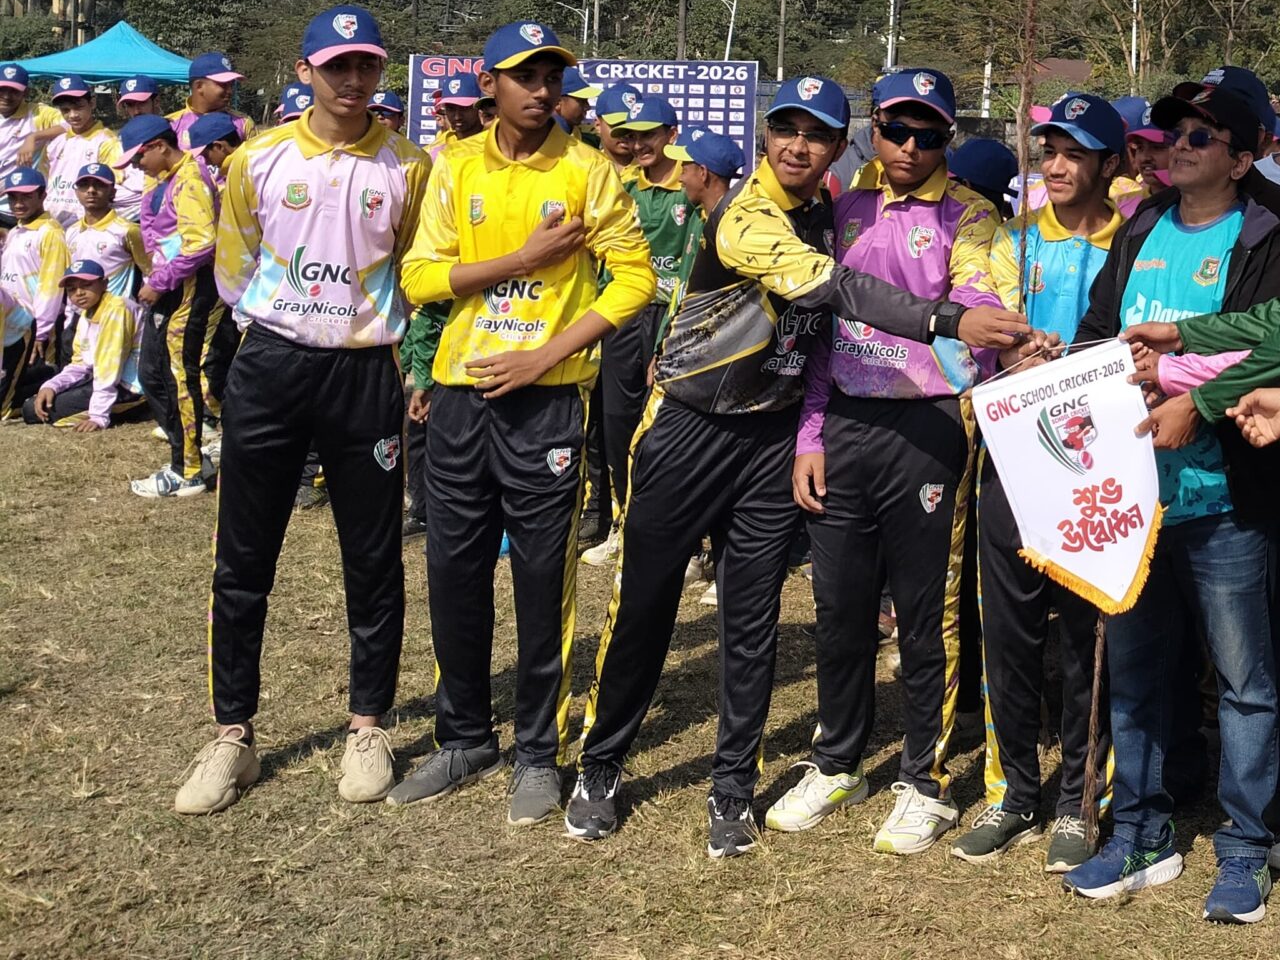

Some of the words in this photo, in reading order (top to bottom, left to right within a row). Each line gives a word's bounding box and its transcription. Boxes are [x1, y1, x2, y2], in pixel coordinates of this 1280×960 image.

[596, 63, 748, 80] CRICKET-2026
[369, 188, 386, 197] GNC
[651, 256, 675, 269] NC
[493, 279, 543, 300] GNC
[273, 298, 358, 318] GrayNicols
[833, 339, 908, 359] GrayNicols
[862, 356, 907, 369] Cricketers
[986, 393, 1021, 422] GNC
[1020, 383, 1058, 409] SCHOOL
[1059, 358, 1125, 393] CRICKET-2026
[1050, 394, 1089, 418] GNC
[1051, 413, 1070, 425] SCHOOL
[1070, 405, 1091, 418] CRICKET
[1072, 477, 1123, 519] শুভ
